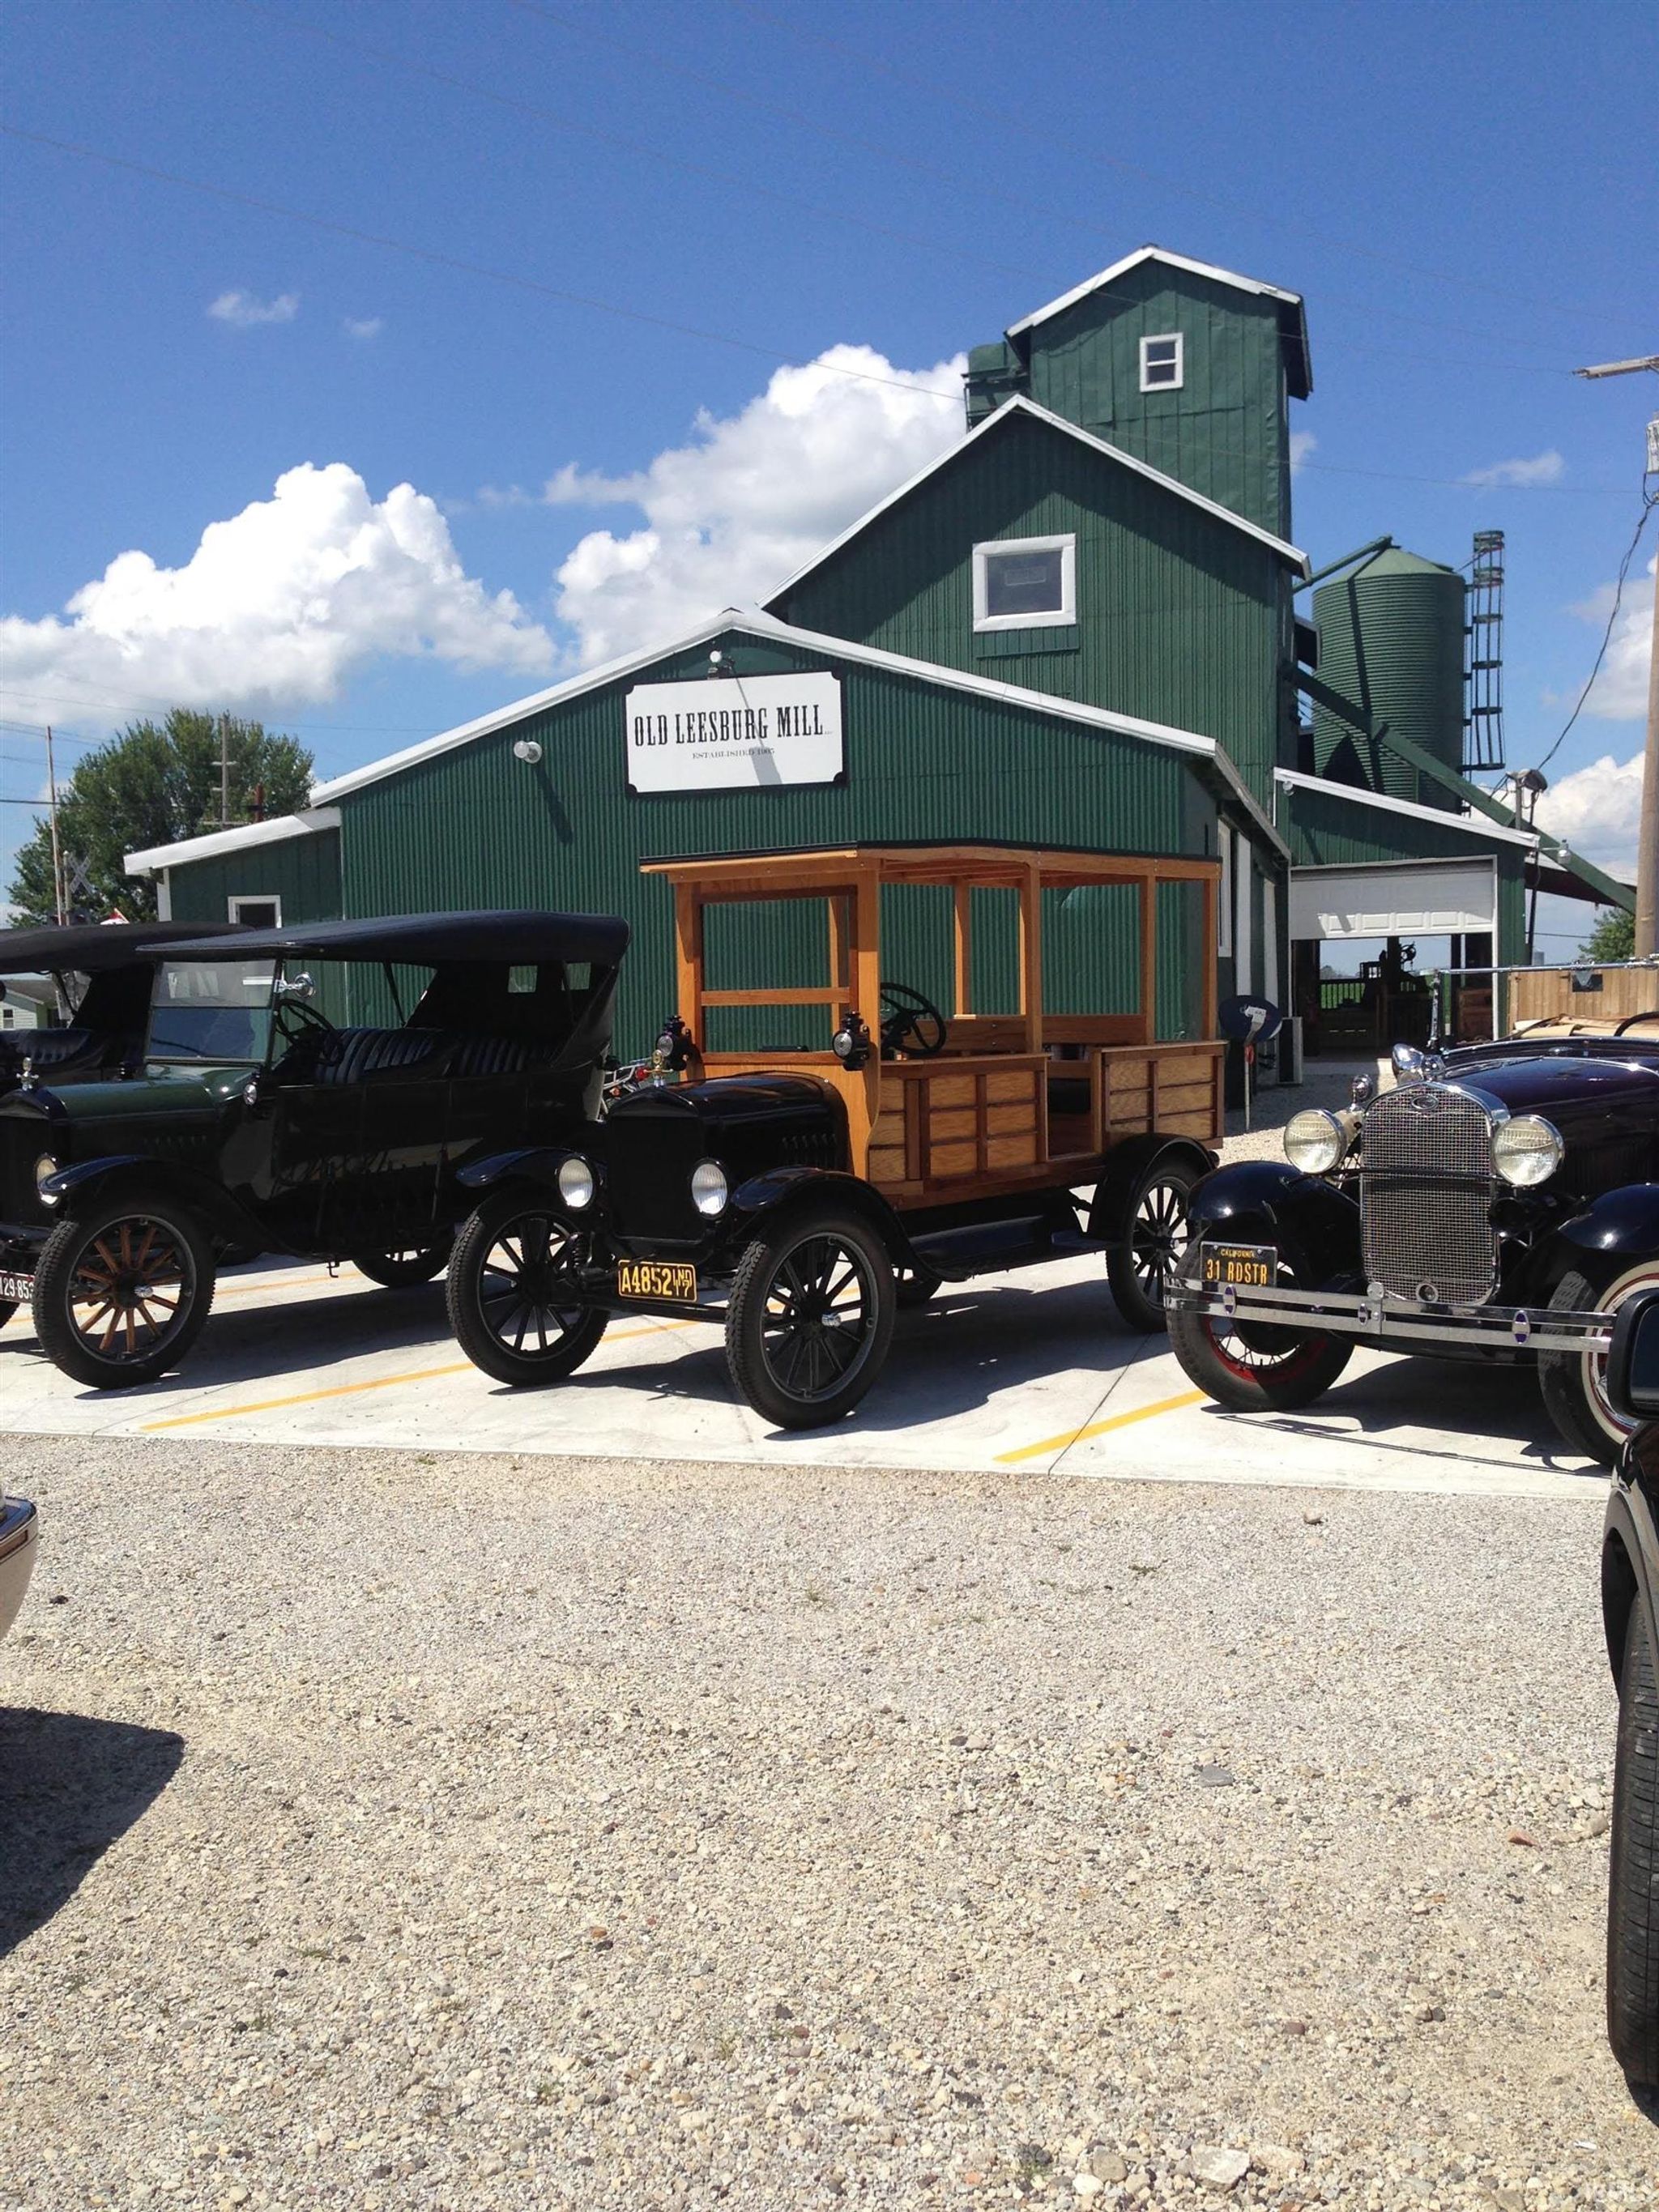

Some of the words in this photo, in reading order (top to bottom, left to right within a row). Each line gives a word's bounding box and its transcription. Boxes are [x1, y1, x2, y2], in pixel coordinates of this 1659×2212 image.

[634, 714, 667, 746] OLD
[676, 707, 768, 744] LEESBURG
[776, 704, 823, 738] MILL
[692, 748, 755, 759] ESTABLISHED
[621, 1266, 672, 1296] A4852
[1206, 1259, 1221, 1280] 31
[1227, 1261, 1268, 1285] RDSTR
